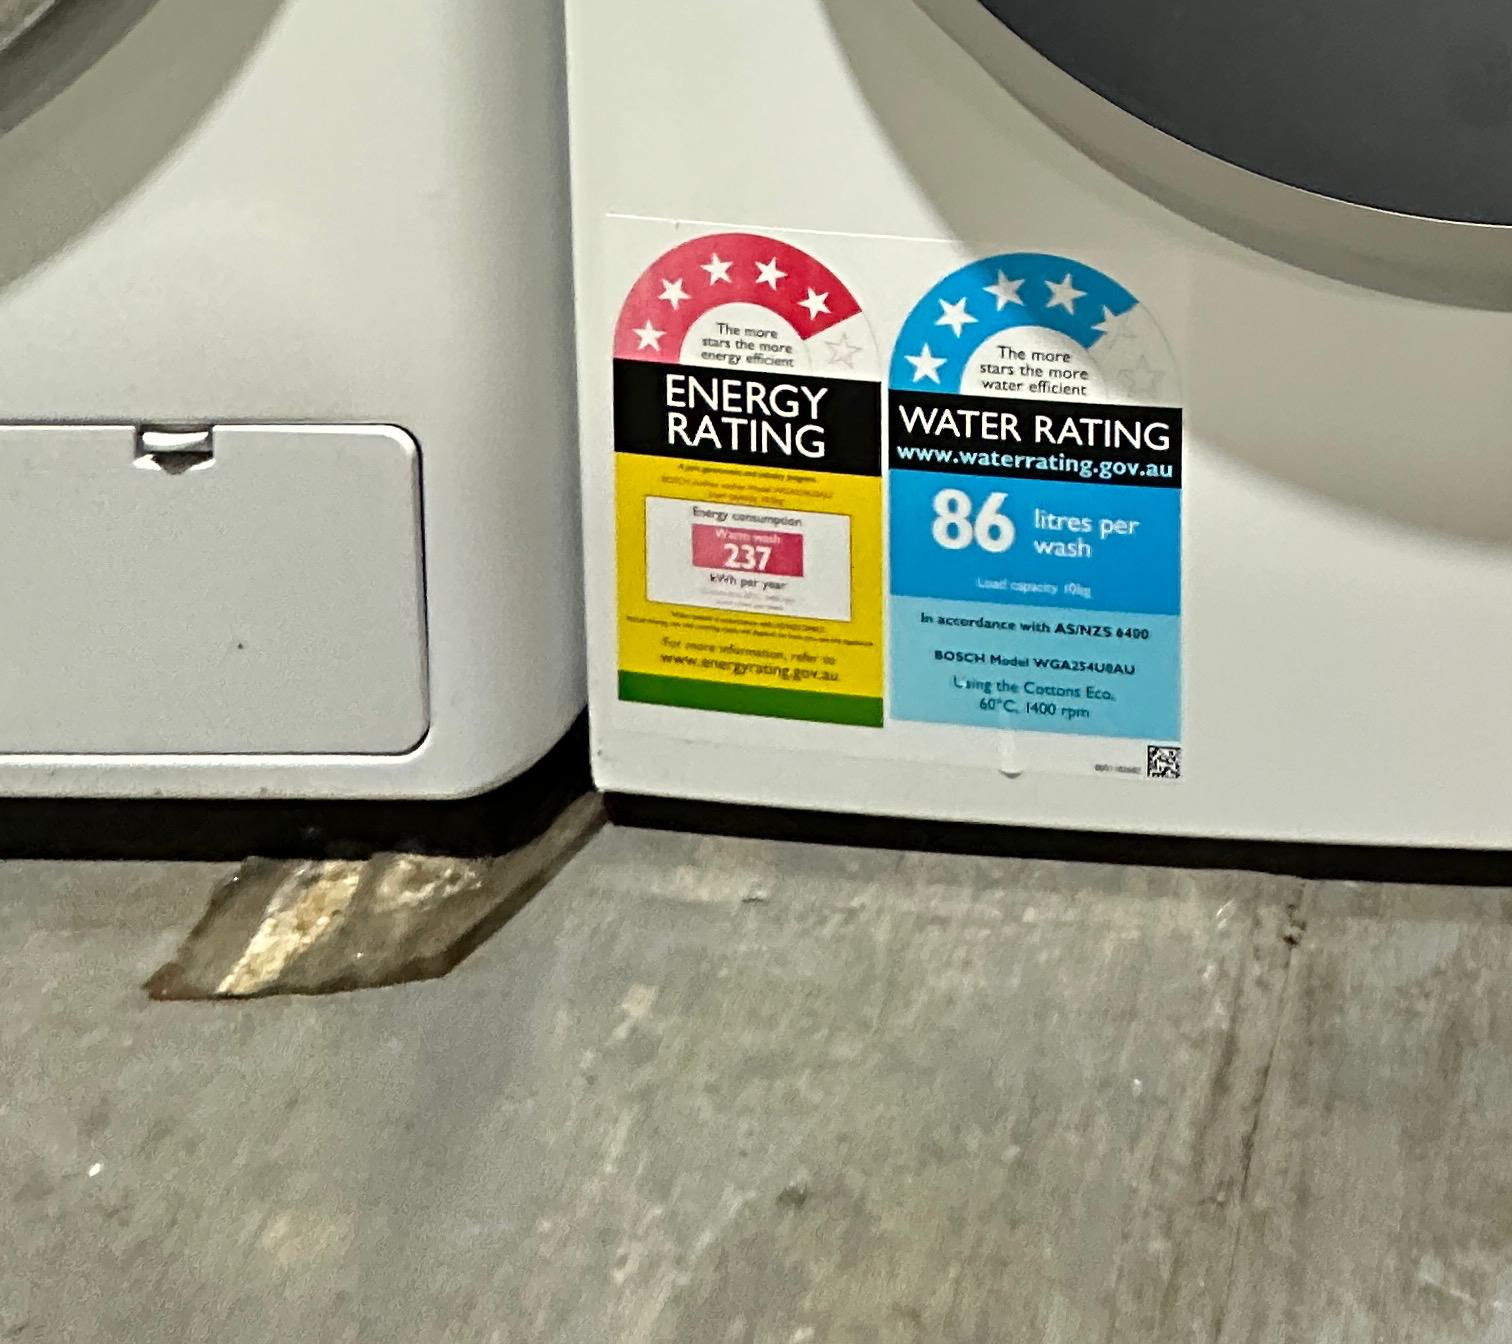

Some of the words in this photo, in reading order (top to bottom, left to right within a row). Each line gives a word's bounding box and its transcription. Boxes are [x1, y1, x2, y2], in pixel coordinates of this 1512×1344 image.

[717, 322, 740, 336] The
[744, 328, 778, 339] more
[702, 337, 730, 349] stars
[736, 339, 754, 350] the
[759, 342, 793, 354] more
[996, 345, 1026, 361] The
[1031, 349, 1071, 363] more
[701, 351, 742, 365] energy
[745, 354, 794, 368] efficient
[980, 362, 1014, 376] stars
[1019, 363, 1043, 378] the
[1048, 367, 1089, 381] more
[666, 373, 829, 420] ENERGY
[981, 379, 1022, 393] water
[1029, 380, 1087, 396] efficient
[668, 412, 825, 458] RATING
[899, 404, 1021, 442] WATER
[1035, 414, 1170, 451] RATING
[897, 444, 1173, 479] www.waterrating.gov.au
[692, 506, 728, 522] Energy
[732, 513, 802, 527] consumption
[932, 488, 1016, 553] 86
[1034, 508, 1093, 533] litres
[1100, 518, 1140, 539] per
[724, 543, 772, 570] 237
[1033, 537, 1092, 558] wash
[710, 573, 736, 585] kWh
[920, 612, 934, 623] In
[937, 616, 1016, 631] accordance
[1020, 620, 1050, 633] with
[1055, 623, 1112, 638] AS/NZS
[1116, 628, 1149, 640] 6400
[934, 650, 985, 663] BOSCH
[990, 654, 1029, 667] Model
[996, 677, 1018, 693] the
[1023, 681, 1081, 698] Cottons
[1026, 702, 1056, 716] 1400
[1061, 707, 1090, 720] rpm
